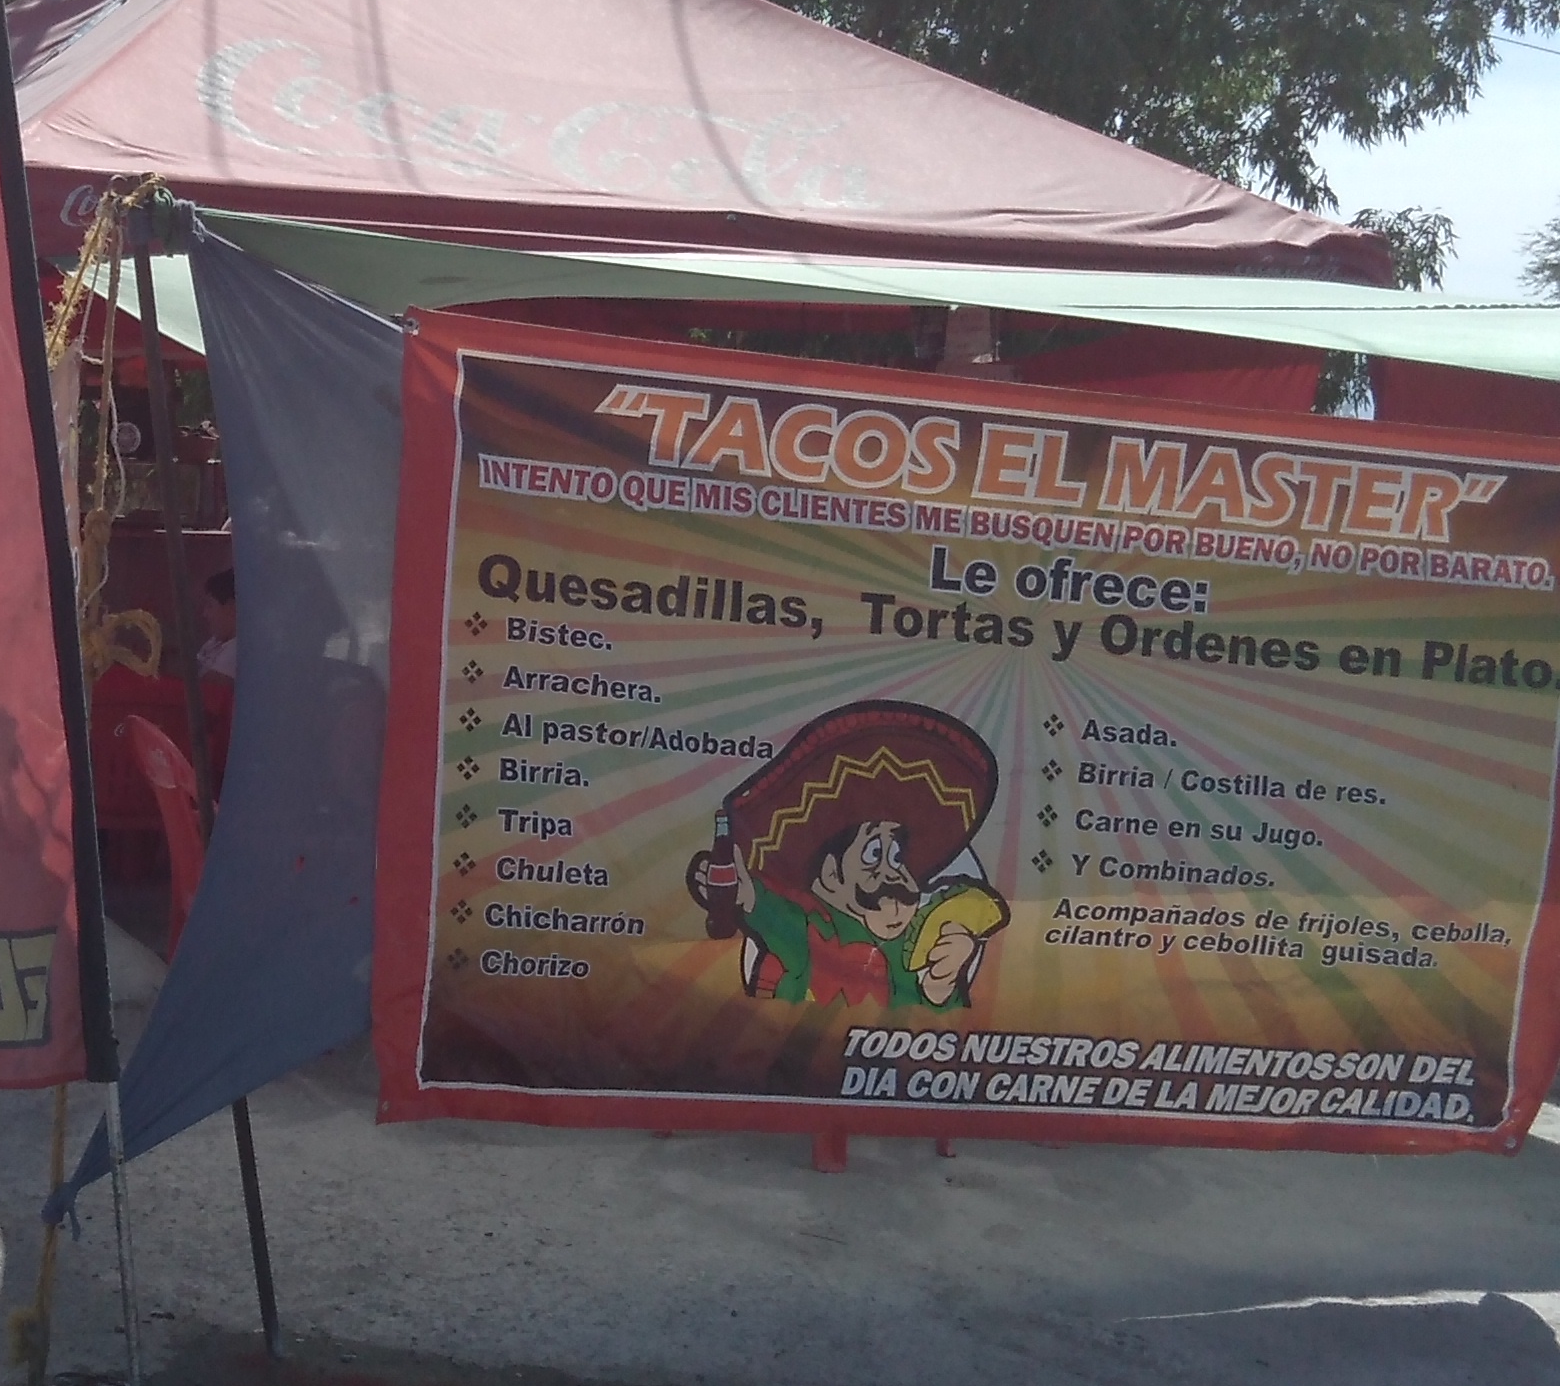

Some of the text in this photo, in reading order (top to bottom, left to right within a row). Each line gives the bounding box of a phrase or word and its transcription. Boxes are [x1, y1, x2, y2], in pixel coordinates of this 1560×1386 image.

[594, 383, 1507, 543] "TACOS EL MASTER"
[480, 457, 1552, 588] INTENTO QUE MIS CLIENTES ME BUSQUEN POR BUENO, NO POR BARATO.
[930, 544, 1209, 613] Le ofrece:
[478, 554, 823, 639] Quesadillas,
[861, 592, 1034, 647] Tortas
[1052, 620, 1082, 662] y
[1100, 614, 1320, 671] Ordenes
[1340, 643, 1401, 677] en
[506, 617, 612, 650] Bistec.
[503, 666, 662, 703] Arrachera.
[501, 713, 774, 759] Al pastor/Adobada
[1081, 719, 1177, 747] Asada.
[499, 758, 589, 787] Birria.
[1077, 762, 1155, 788] Birria
[1180, 770, 1286, 799] Costilla
[1295, 779, 1327, 801] de
[1336, 785, 1386, 805] res.
[498, 809, 572, 840] Tripa
[1075, 809, 1323, 850] Carne en su Jugo.
[496, 857, 609, 886] Chuleta
[1071, 853, 1275, 887] Y Combinados.
[484, 903, 644, 935] Chicharrón
[1052, 897, 1511, 947] Acompañados de frijoles, cebolla,
[1044, 925, 1152, 949] cilantro
[1157, 933, 1176, 955] y
[1183, 932, 1303, 959] cebollita
[480, 950, 589, 978] Chorizo
[843, 1028, 1474, 1087] TODOS NUESTROS ALIMENTOS SON DEL
[841, 1066, 1474, 1123] DIA CON CARNE DE LA MEJOR CALIDAD.
